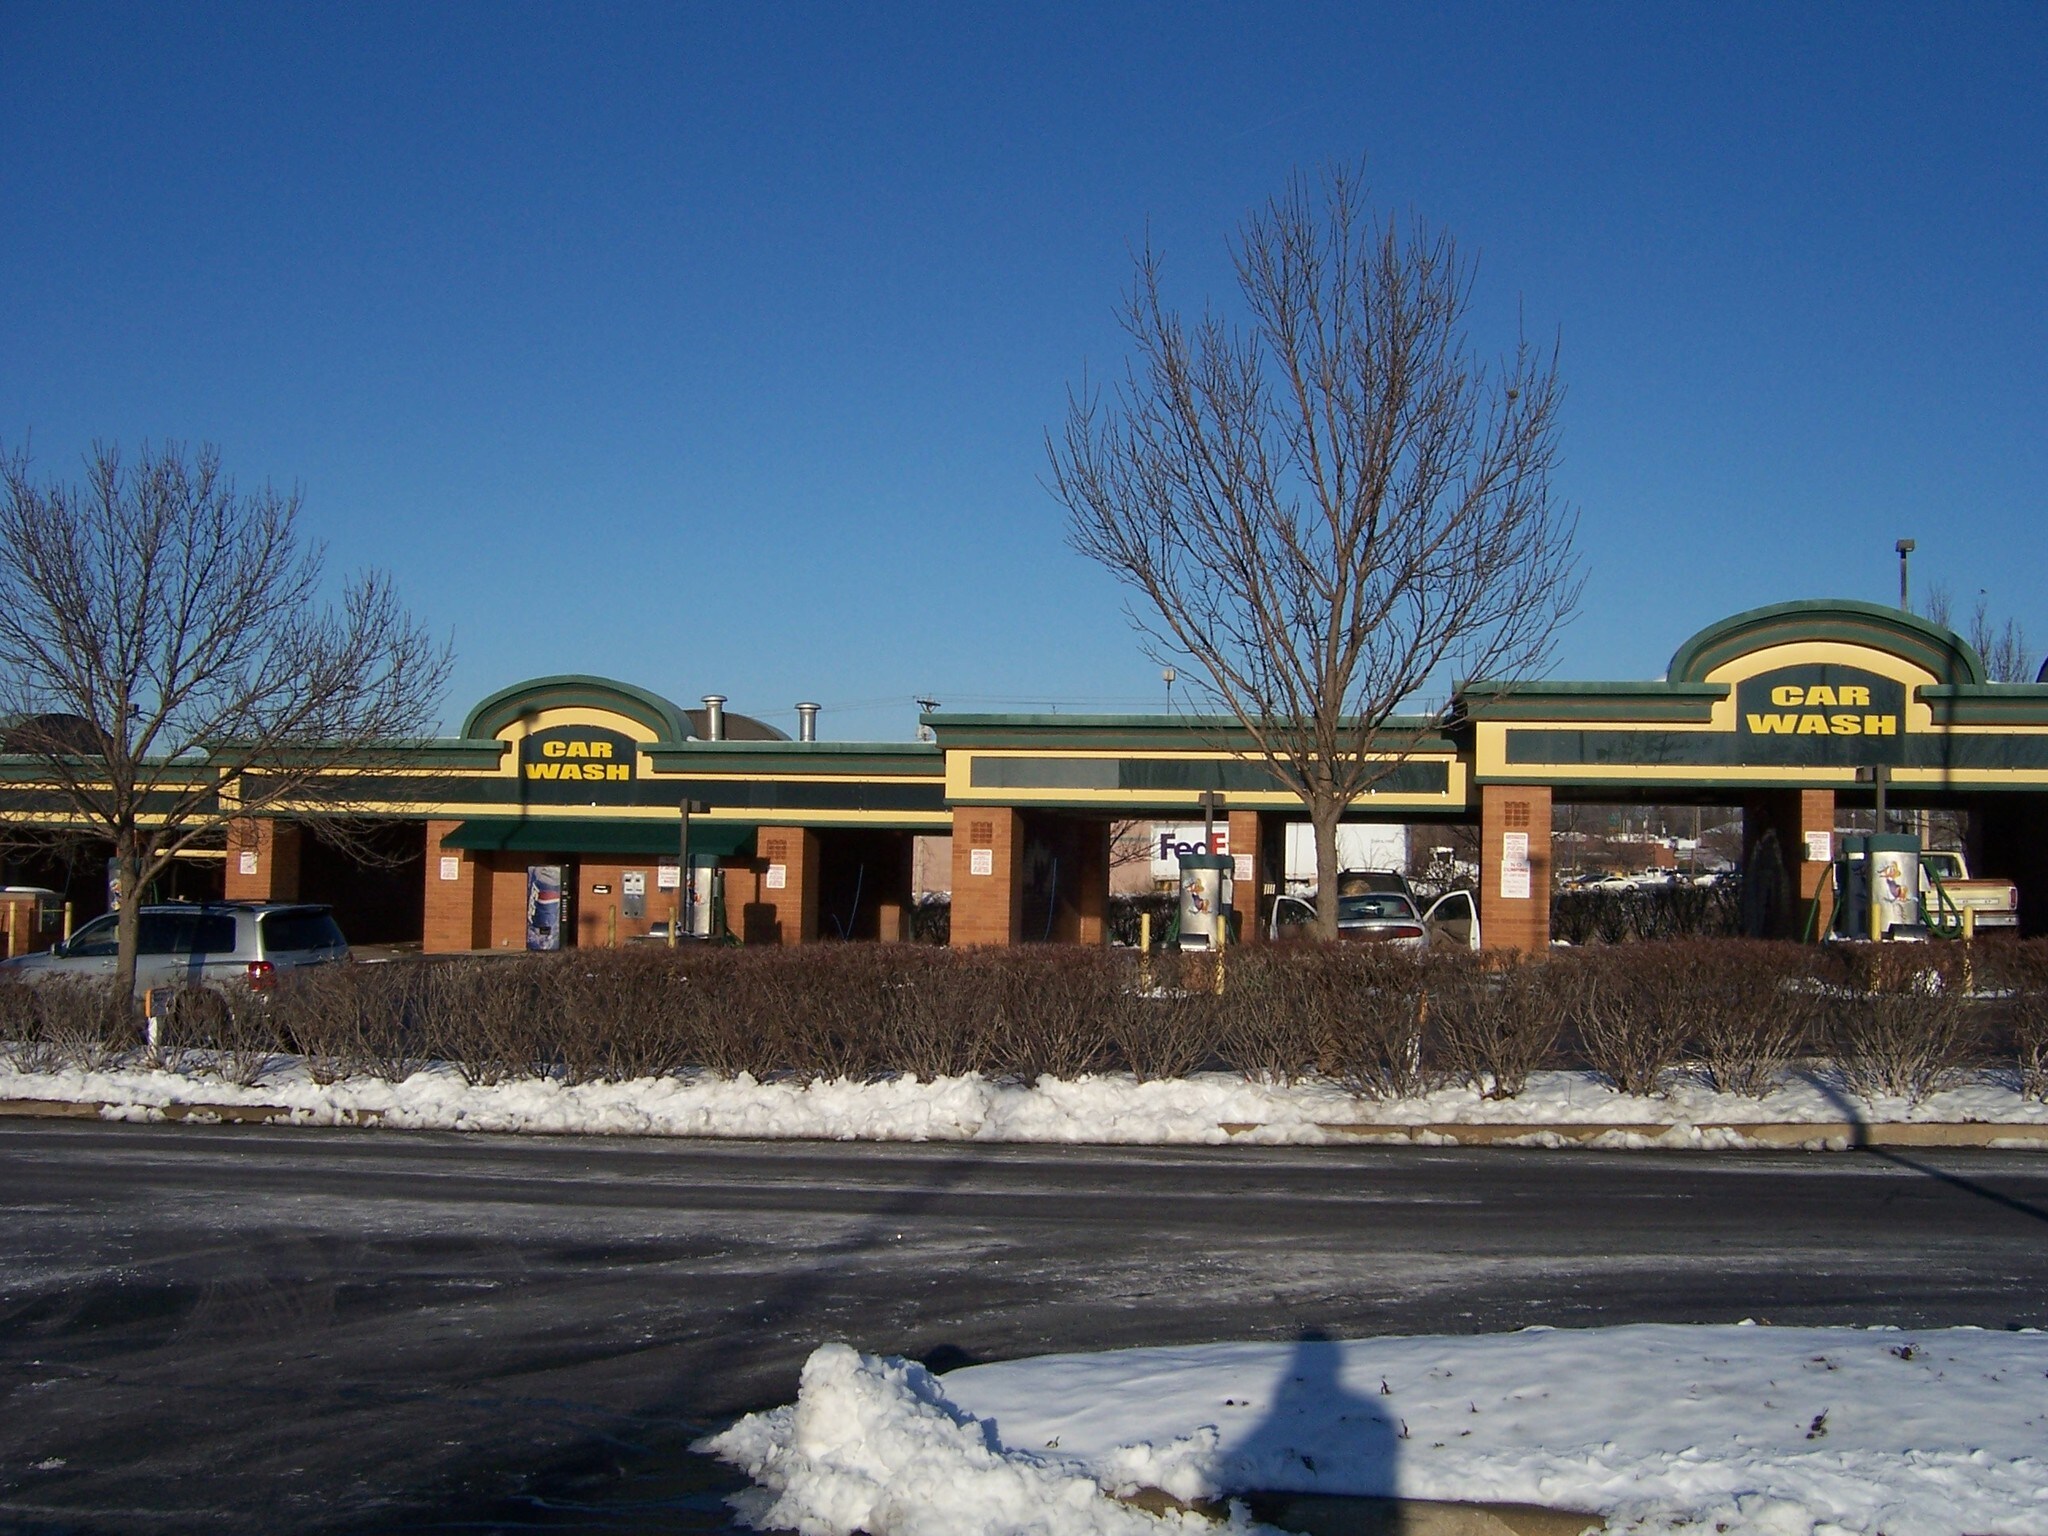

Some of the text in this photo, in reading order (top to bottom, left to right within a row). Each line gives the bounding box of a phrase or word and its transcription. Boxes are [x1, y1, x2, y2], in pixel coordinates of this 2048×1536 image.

[1771, 685, 1870, 707] CAR
[1746, 713, 1896, 735] WASH
[542, 740, 612, 758] CAR
[525, 763, 629, 780] WASH
